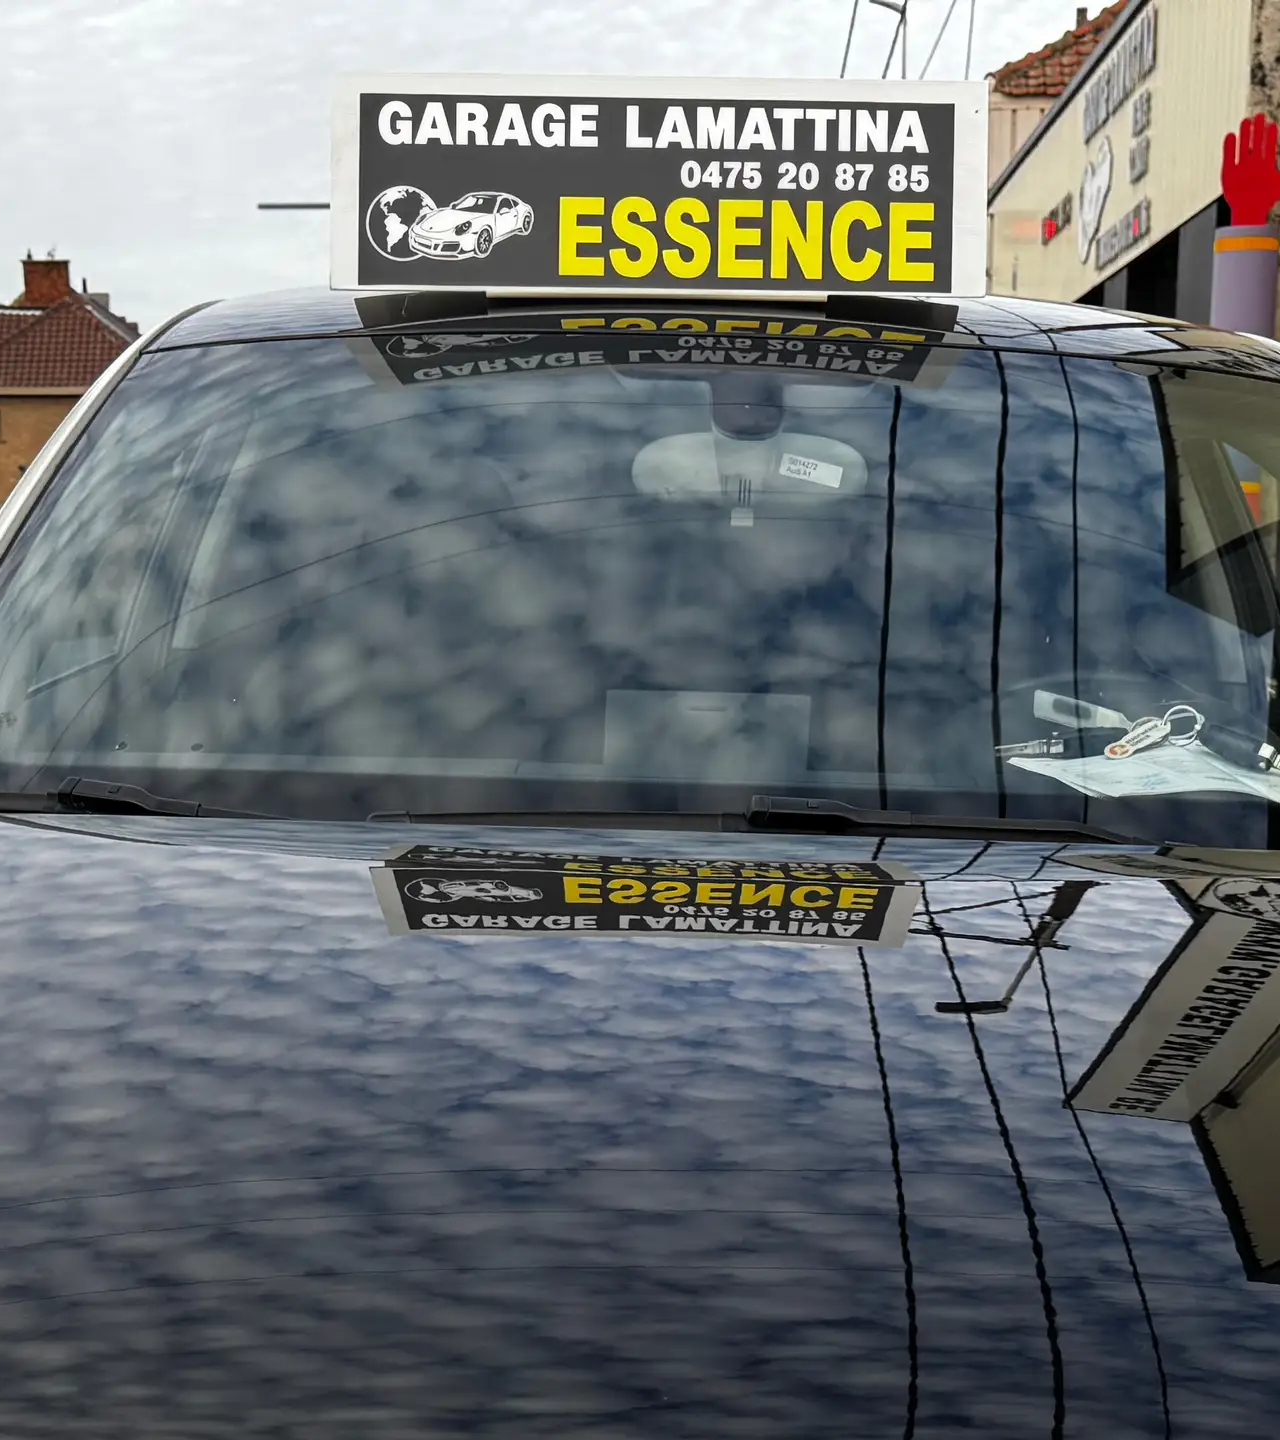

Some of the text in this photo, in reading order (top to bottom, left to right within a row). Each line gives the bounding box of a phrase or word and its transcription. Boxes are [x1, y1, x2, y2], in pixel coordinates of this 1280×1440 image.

[377, 100, 930, 154] GARAGE LAMATTINA
[680, 160, 930, 193] 0475 20 87 85
[558, 196, 935, 282] ESSENCE
